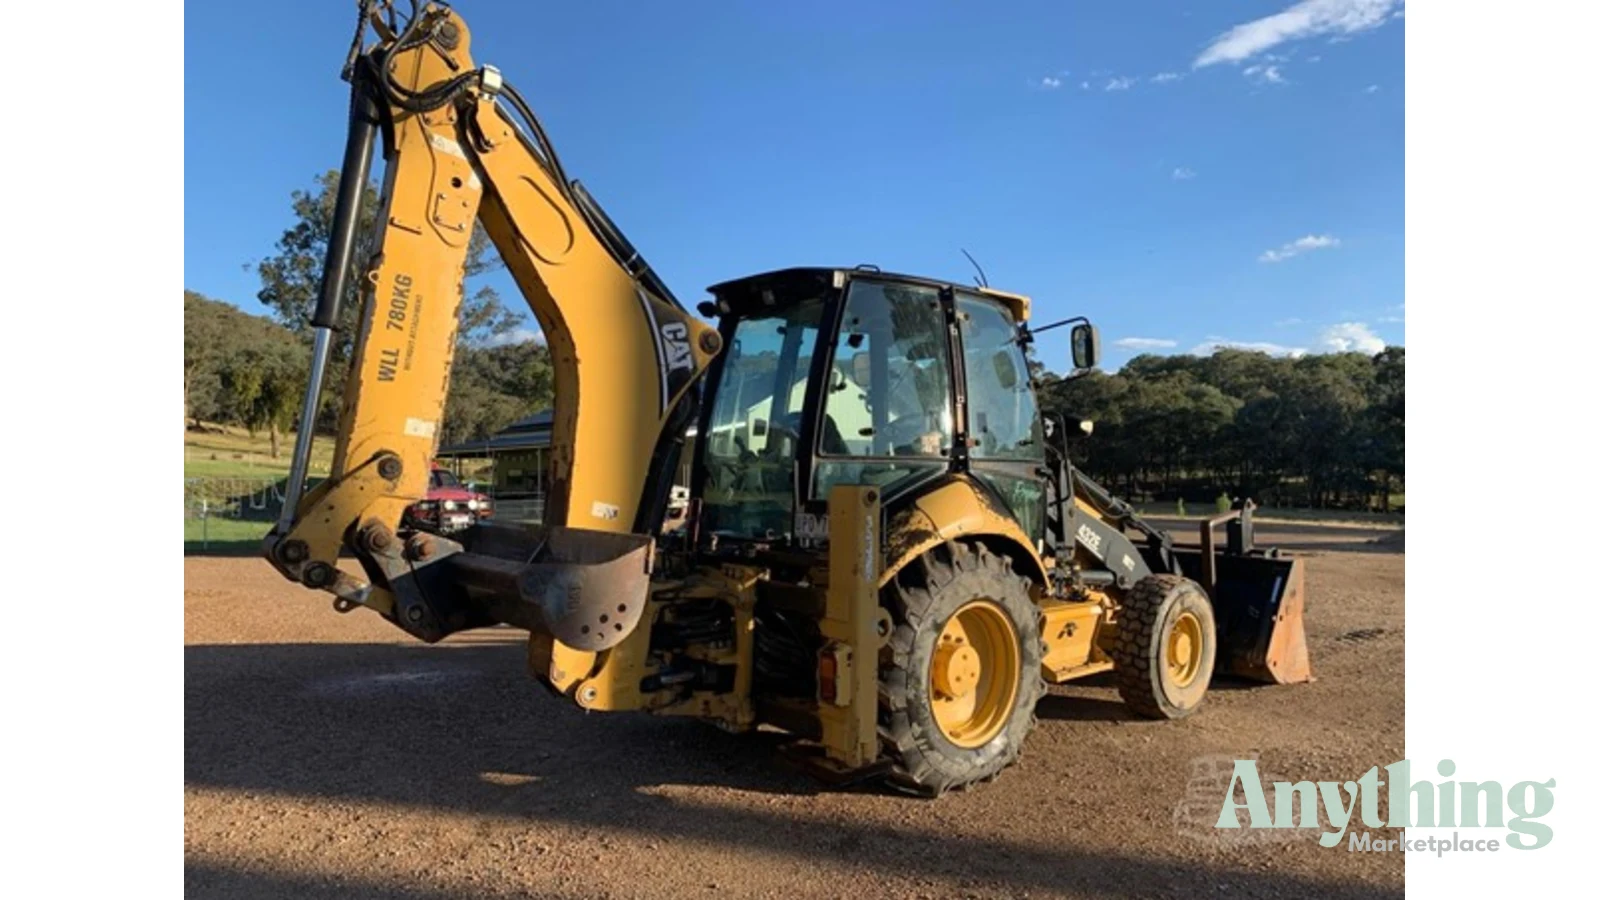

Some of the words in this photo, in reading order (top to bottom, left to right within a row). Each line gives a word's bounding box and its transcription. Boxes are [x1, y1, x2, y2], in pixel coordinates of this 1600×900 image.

[386, 273, 413, 332] 780KG
[377, 348, 400, 382] WLL
[661, 322, 694, 371] CAT
[1078, 524, 1102, 551] 432E
